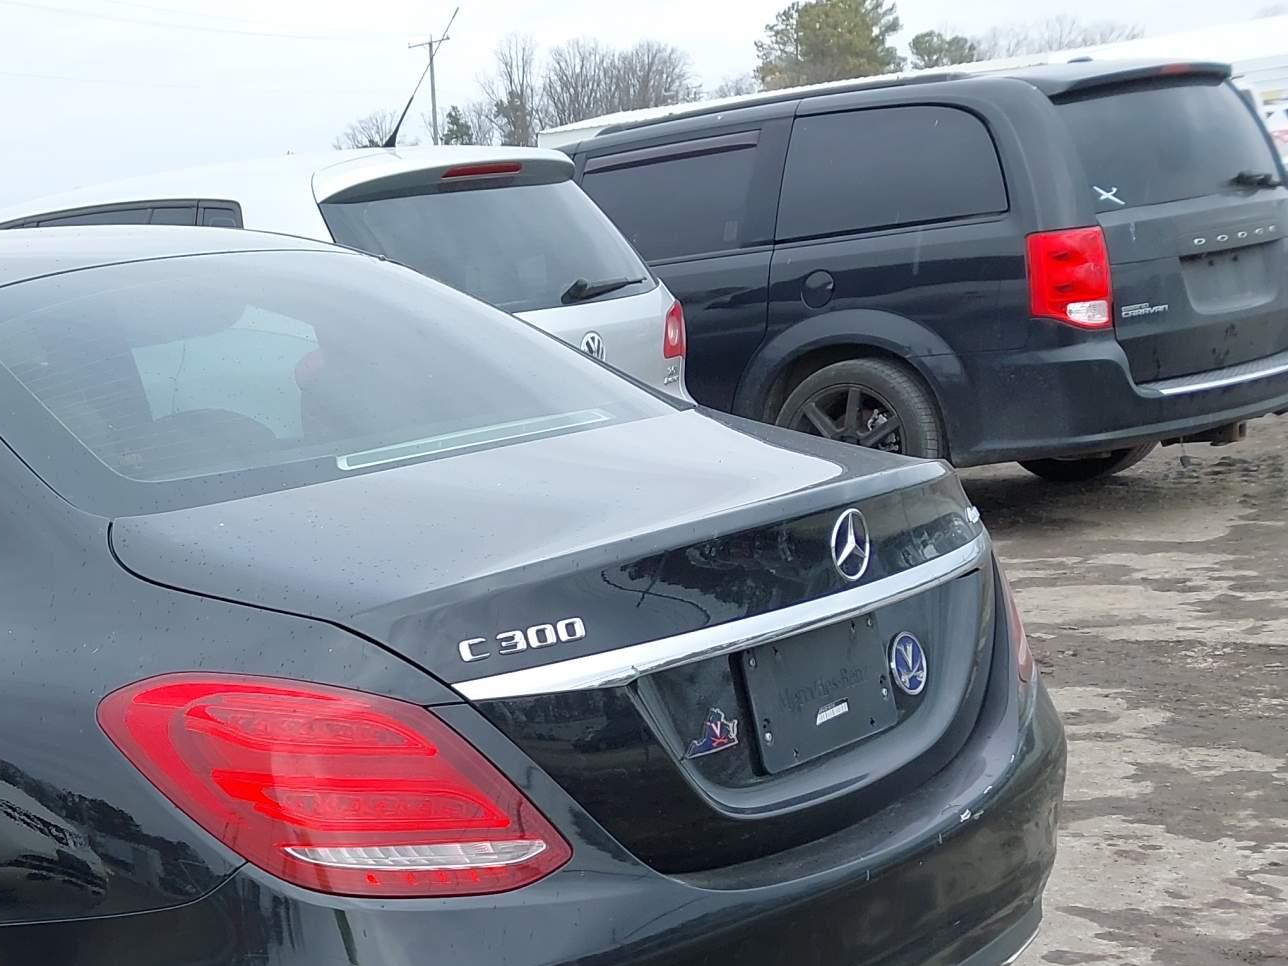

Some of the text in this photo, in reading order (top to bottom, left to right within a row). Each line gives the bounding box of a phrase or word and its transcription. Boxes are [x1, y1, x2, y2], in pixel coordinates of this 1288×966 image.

[1193, 225, 1275, 246] DODGE
[1121, 305, 1169, 318] CARAVAN
[458, 616, 587, 662] C 300
